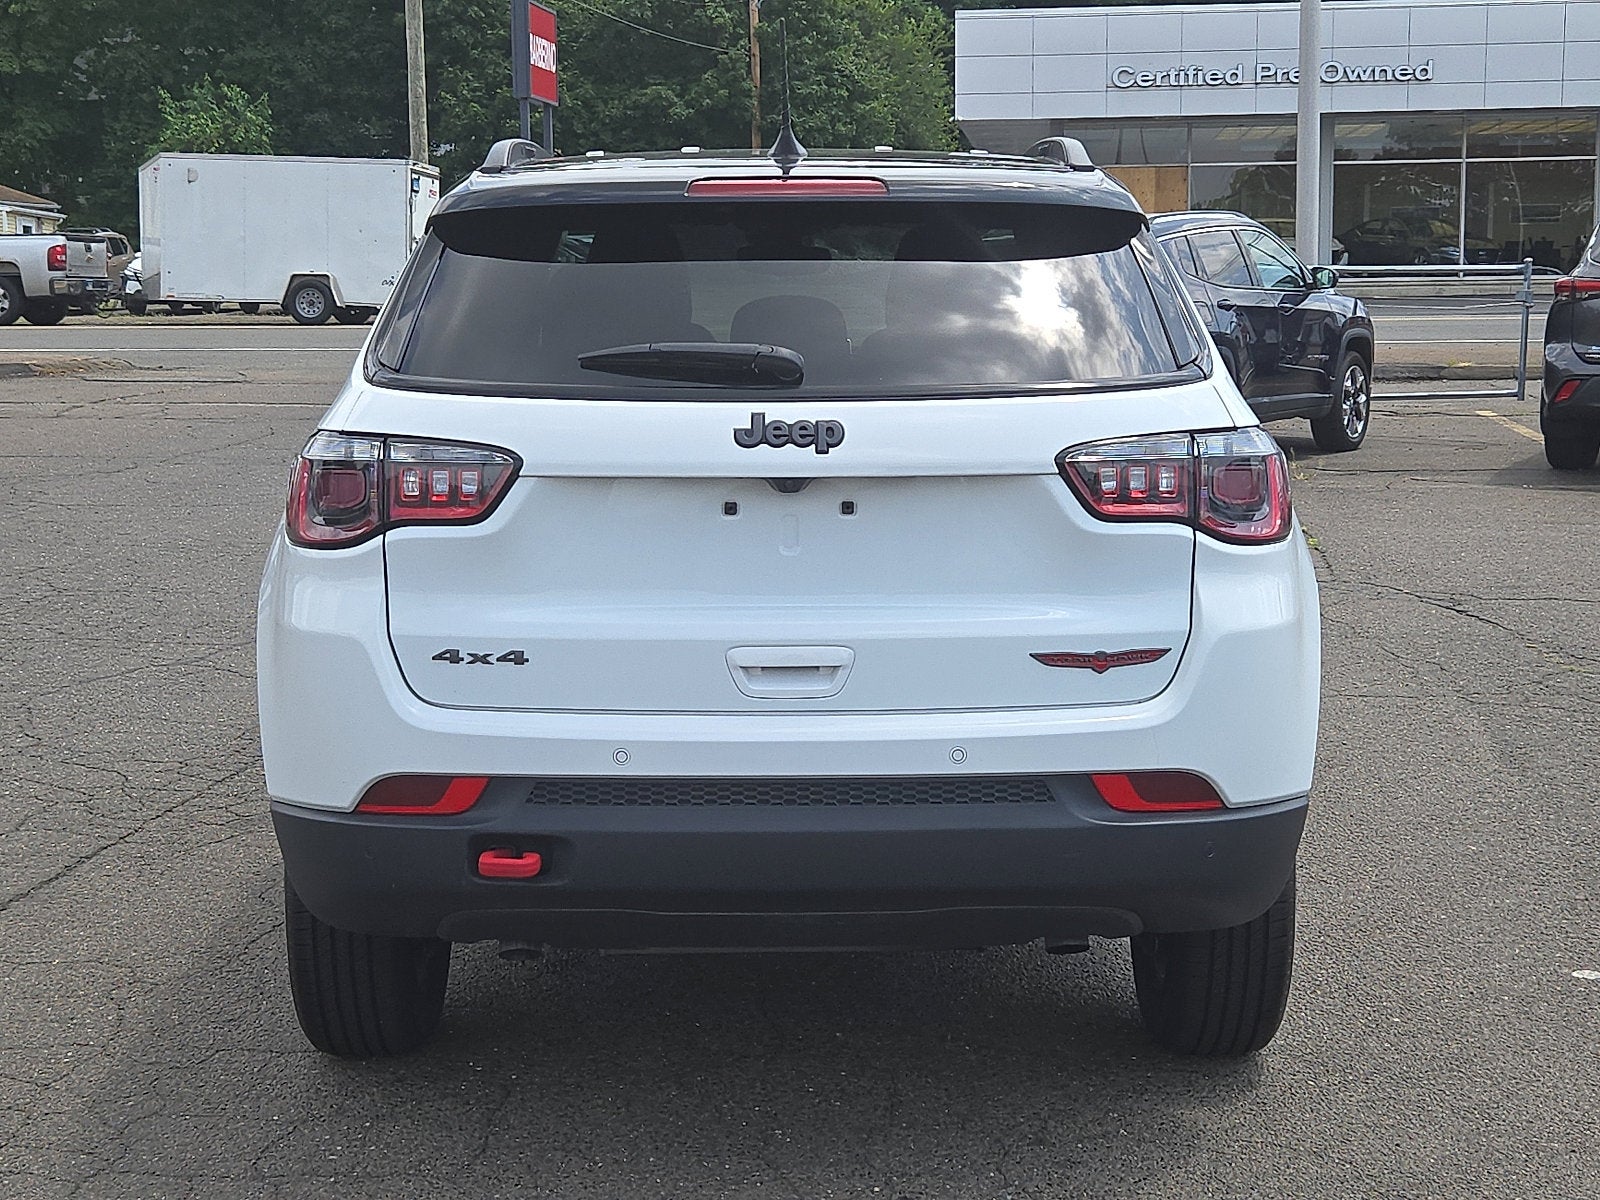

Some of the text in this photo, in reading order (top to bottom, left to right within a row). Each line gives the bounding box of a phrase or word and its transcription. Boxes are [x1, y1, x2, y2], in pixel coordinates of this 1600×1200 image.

[1111, 63, 1243, 88] Certified
[1319, 59, 1434, 83] Owned
[733, 412, 845, 454] Jeep
[431, 649, 530, 665] 4x4
